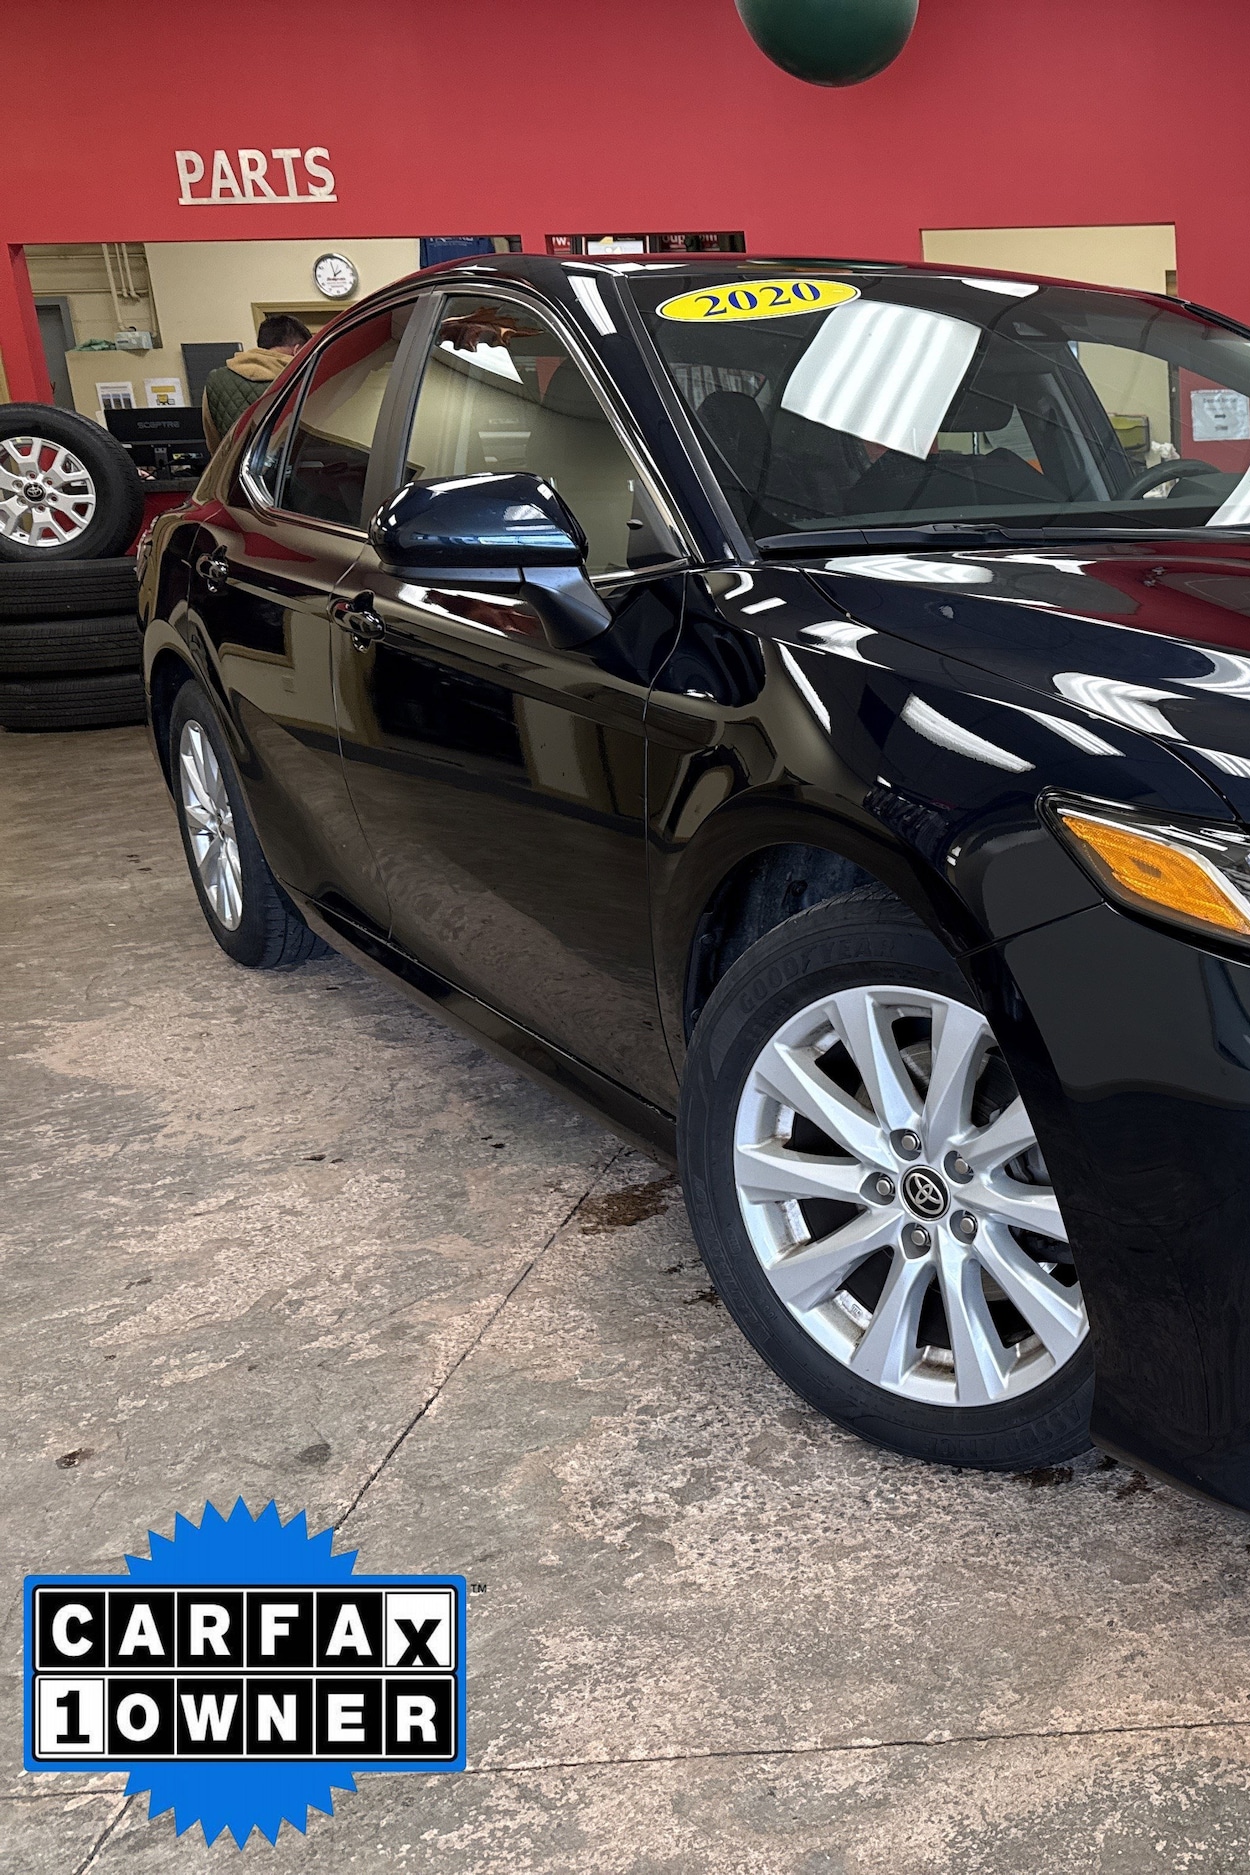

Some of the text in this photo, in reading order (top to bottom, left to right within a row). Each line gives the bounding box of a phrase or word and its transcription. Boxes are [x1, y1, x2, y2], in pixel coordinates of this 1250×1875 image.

[175, 146, 335, 199] PARTS
[694, 282, 821, 317] 2020
[137, 421, 180, 429] SCEPTRE
[738, 935, 897, 1014] GOODYEAR
